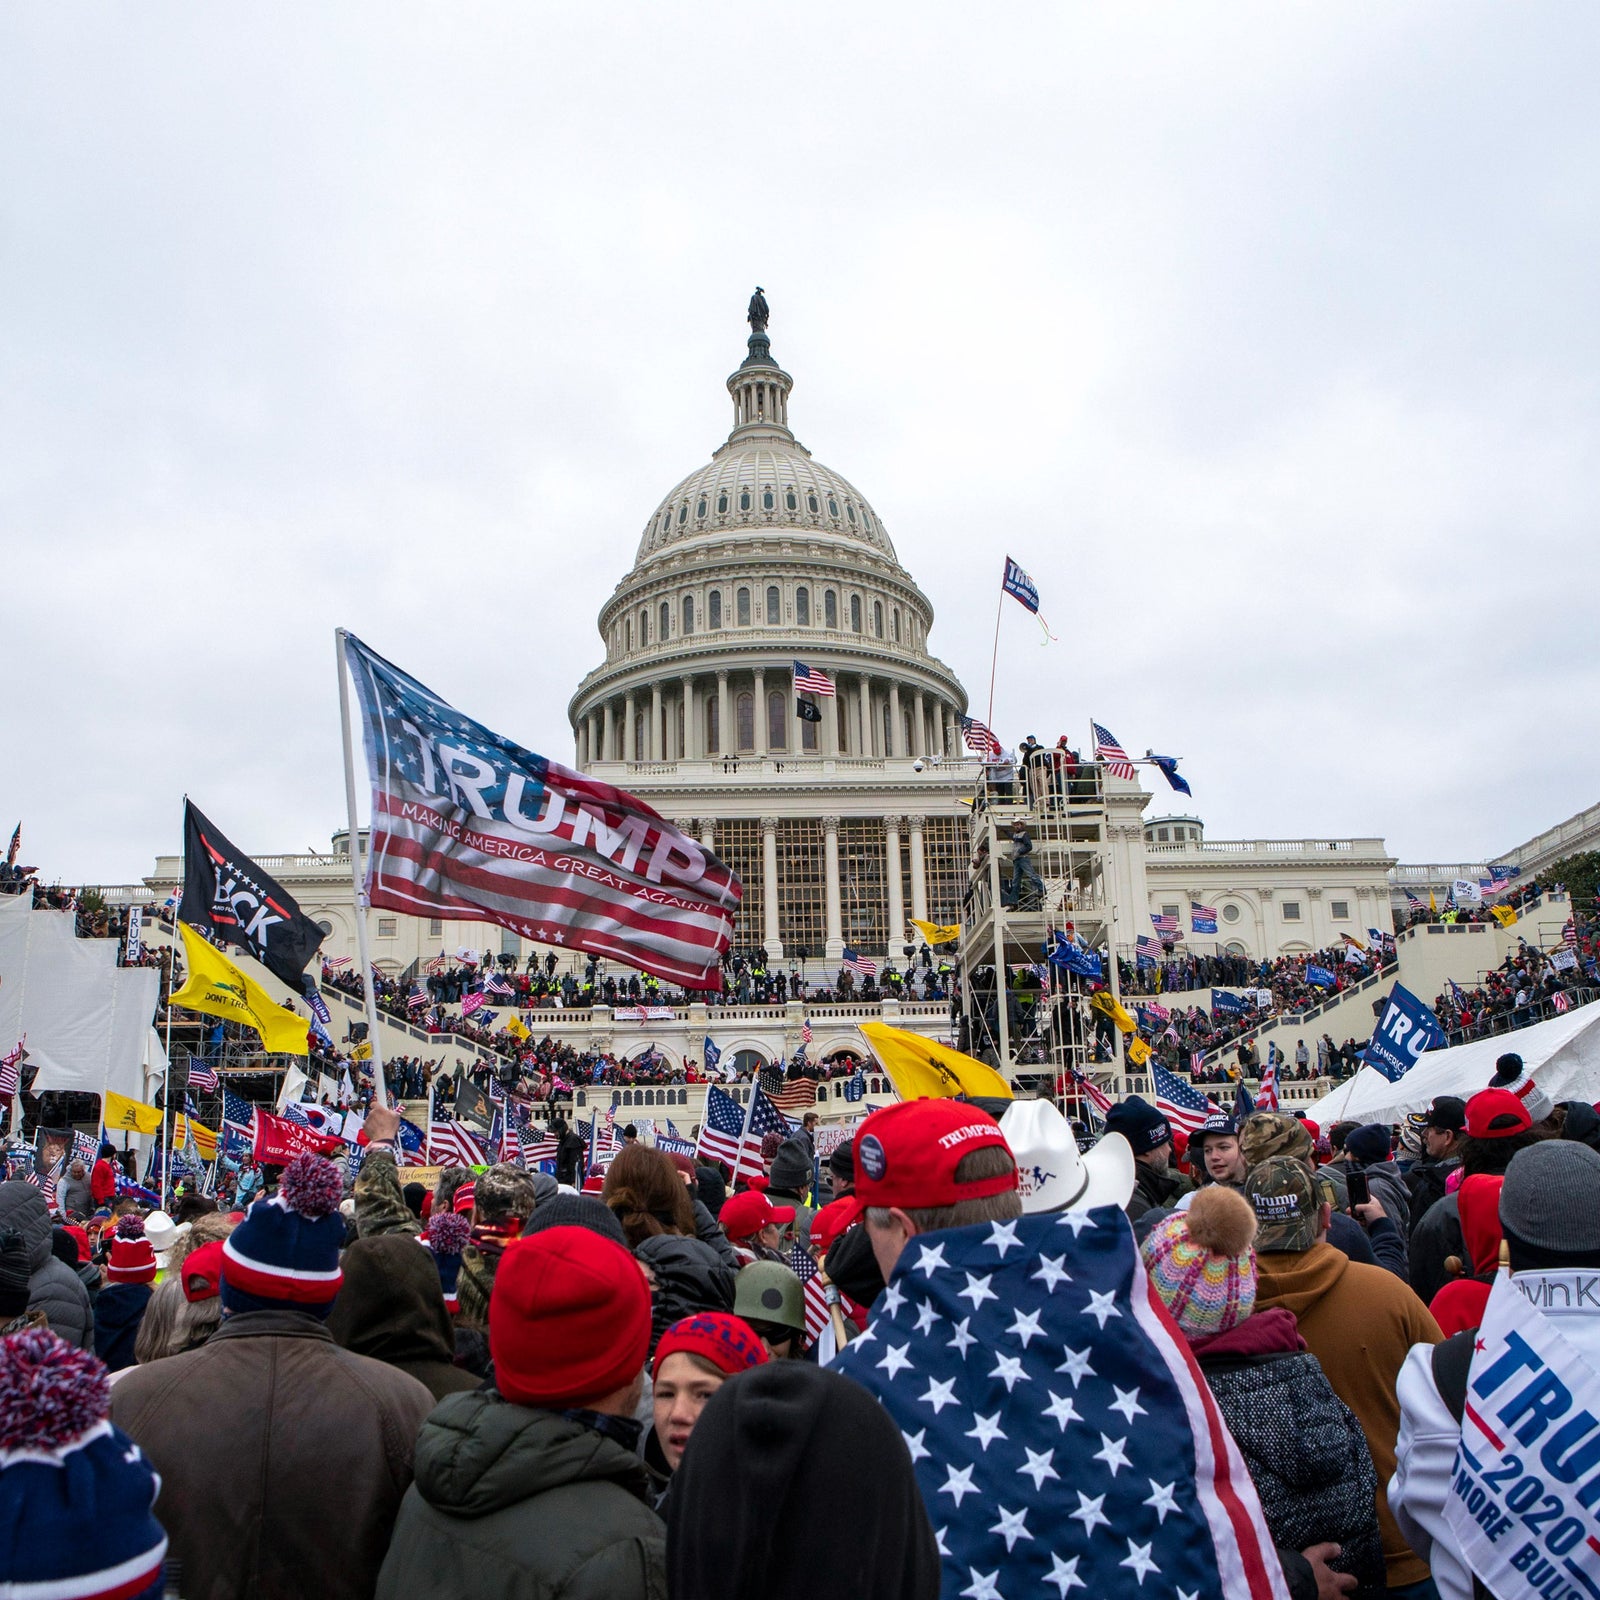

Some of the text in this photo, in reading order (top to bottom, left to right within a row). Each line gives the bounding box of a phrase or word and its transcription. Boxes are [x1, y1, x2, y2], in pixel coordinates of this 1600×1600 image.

[402, 720, 706, 883] TRUMP
[401, 803, 709, 913] MAKING AMERICA GREAT AGAIN!
[128, 908, 140, 960] TRUMP
[205, 992, 248, 1010] DONT TRE
[312, 992, 330, 1022] TRUMP
[1215, 1003, 1241, 1012] LIBERTY
[1381, 1002, 1431, 1058] TRU
[1208, 1121, 1225, 1129] AGAIN
[266, 1145, 284, 1155] KEEP
[659, 1139, 696, 1158] TRUMP
[1252, 1193, 1298, 1207] Trump
[1520, 1277, 1571, 1307] lvin
[1472, 1330, 1600, 1522] TRU
[1452, 1468, 1514, 1543] MORE
[1480, 1453, 1586, 1556] 2020
